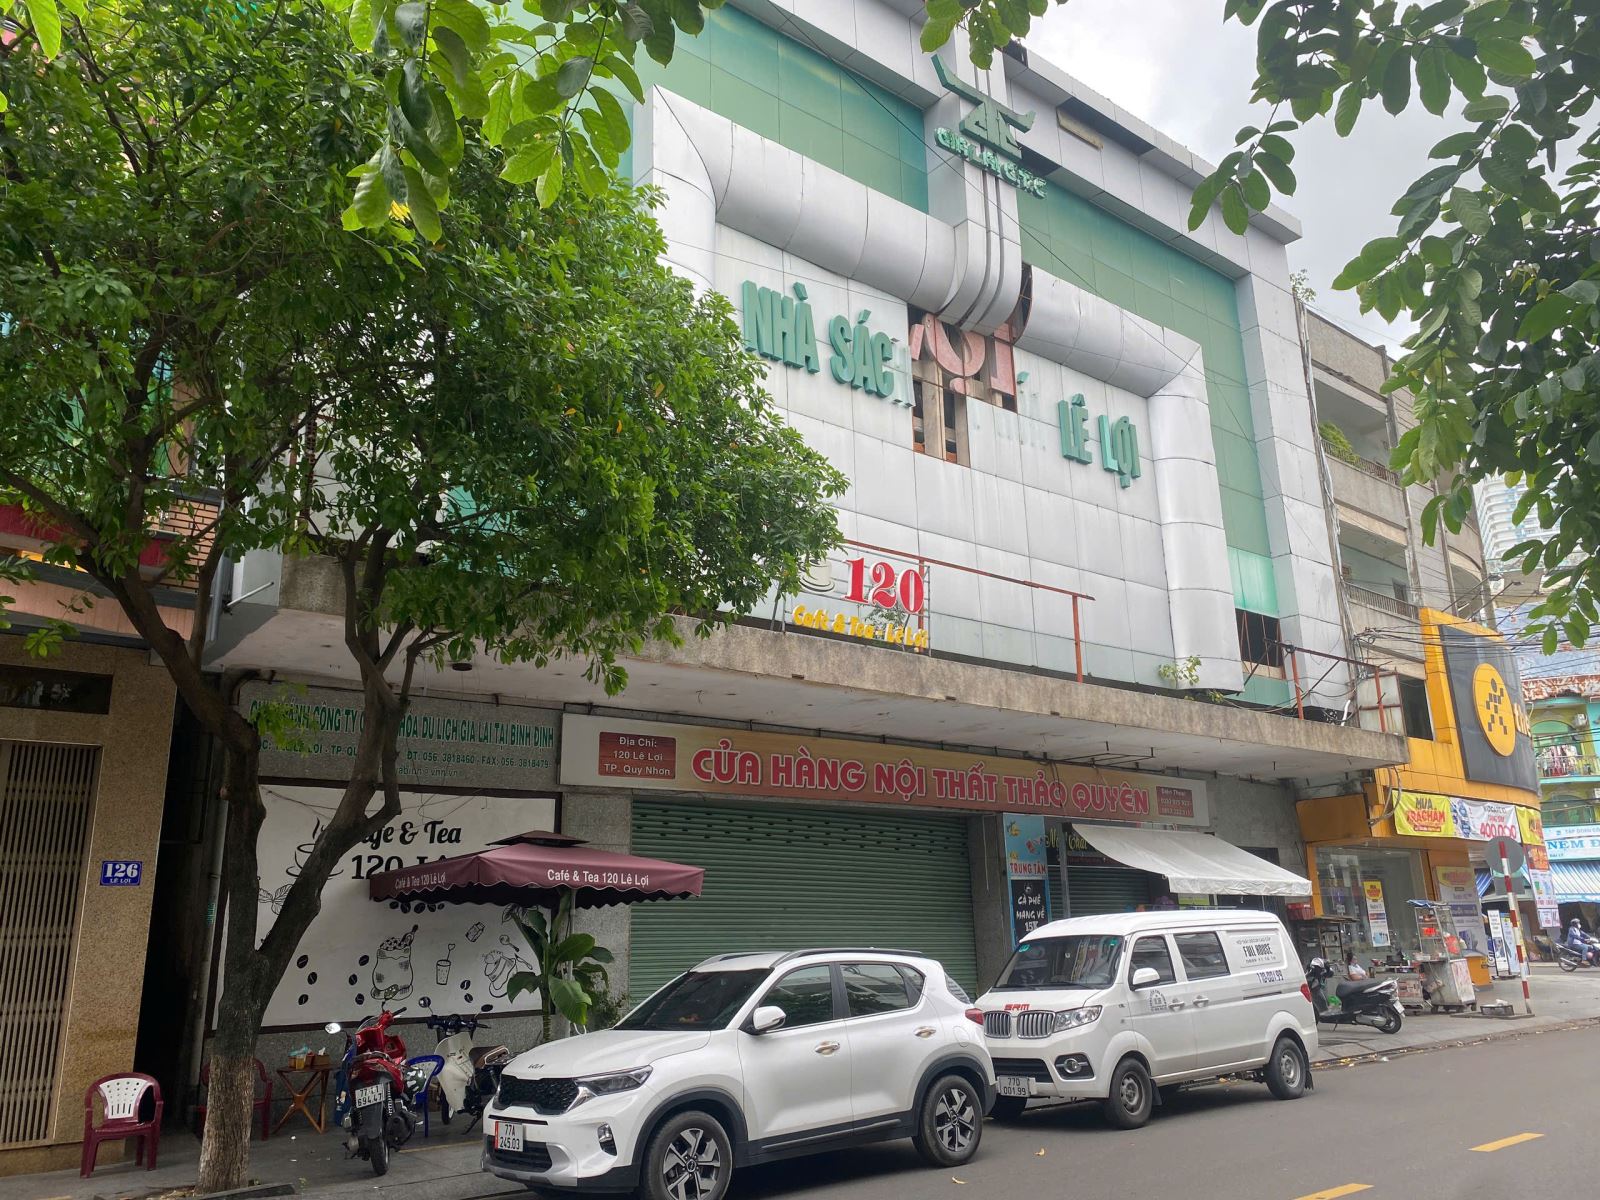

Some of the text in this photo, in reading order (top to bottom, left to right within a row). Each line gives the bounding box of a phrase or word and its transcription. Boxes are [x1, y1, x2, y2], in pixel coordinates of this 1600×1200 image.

[742, 280, 820, 373] NHÀ
[1058, 392, 1092, 465] LÊ
[1098, 415, 1141, 489] LỢI
[841, 557, 924, 614] 120
[832, 612, 845, 634] &
[849, 616, 875, 639] Tea
[344, 709, 358, 733] TY
[422, 716, 434, 740] DU
[437, 717, 458, 746] LỊCH
[460, 719, 476, 743] GIA
[478, 721, 492, 745] LAI
[495, 722, 509, 750] TẠI
[511, 720, 531, 747] BÌNH
[533, 725, 554, 753] ĐỊNH
[619, 735, 658, 748] Địa Chỉ:
[481, 755, 499, 766] FAX:
[613, 750, 663, 763] 120 Lê Lợi
[604, 764, 670, 777] TP. Quy Nhơn
[692, 738, 1150, 815] CỬA HÀNG NỘI THẤT THẢO QUYÊN
[1416, 797, 1433, 809] MUA
[399, 821, 419, 845] &
[424, 820, 461, 844] Tea
[104, 863, 139, 878] 126
[351, 855, 404, 880] 120
[1010, 862, 1032, 874] TRUNG
[411, 876, 420, 887] Tea
[421, 874, 430, 886] 120
[430, 873, 438, 885] Lê
[547, 869, 649, 888] Café & Tea 120 Lê Lợi
[1028, 894, 1041, 905] PHÊ
[1016, 910, 1035, 919] MANG
[1008, 1077, 1020, 1086] 77D
[1003, 1086, 1026, 1096] 001.99
[505, 1124, 516, 1137] 77A
[500, 1137, 520, 1150] 245.03
